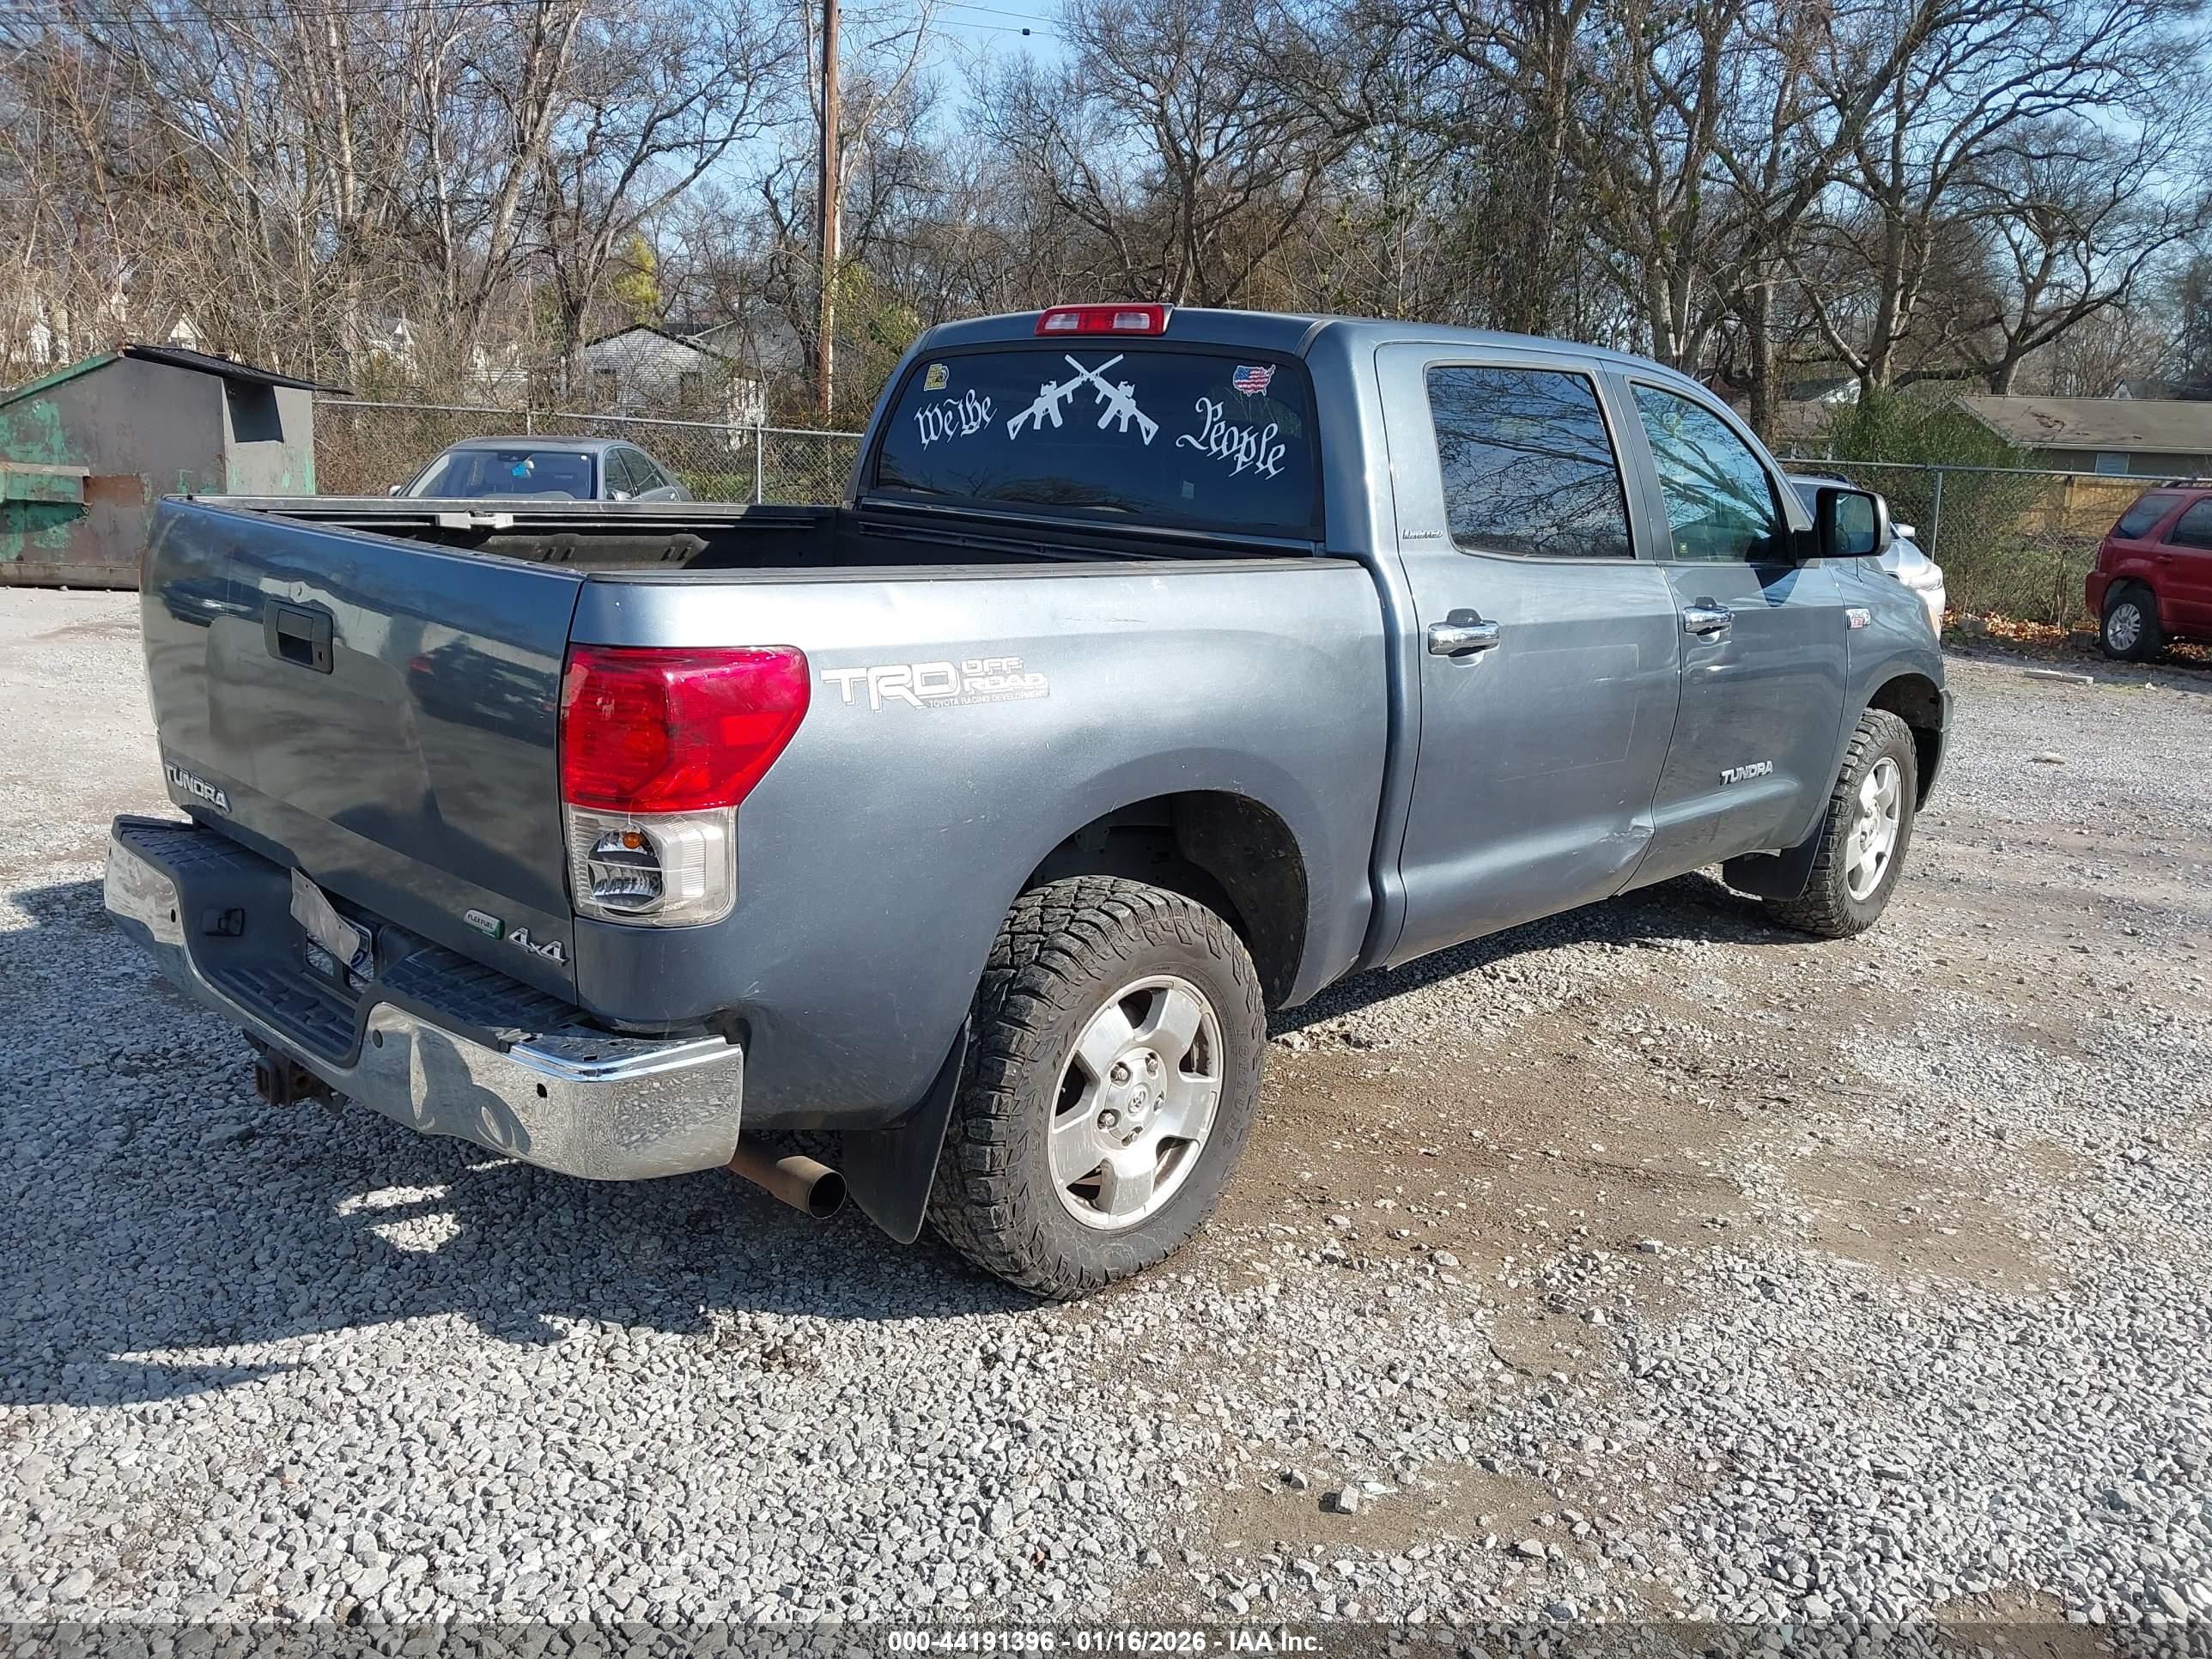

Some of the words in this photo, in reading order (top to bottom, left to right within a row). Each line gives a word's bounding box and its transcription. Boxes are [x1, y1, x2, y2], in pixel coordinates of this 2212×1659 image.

[914, 400, 959, 452] We
[1176, 397, 1286, 481] People
[961, 656, 1024, 676] OFF
[820, 661, 960, 714] TRD
[963, 673, 1049, 696] ROAD
[929, 698, 959, 708] TOYOTA
[961, 694, 990, 705] RACING
[1719, 760, 1773, 785] TUNDRA
[165, 760, 232, 813] TUNDRA
